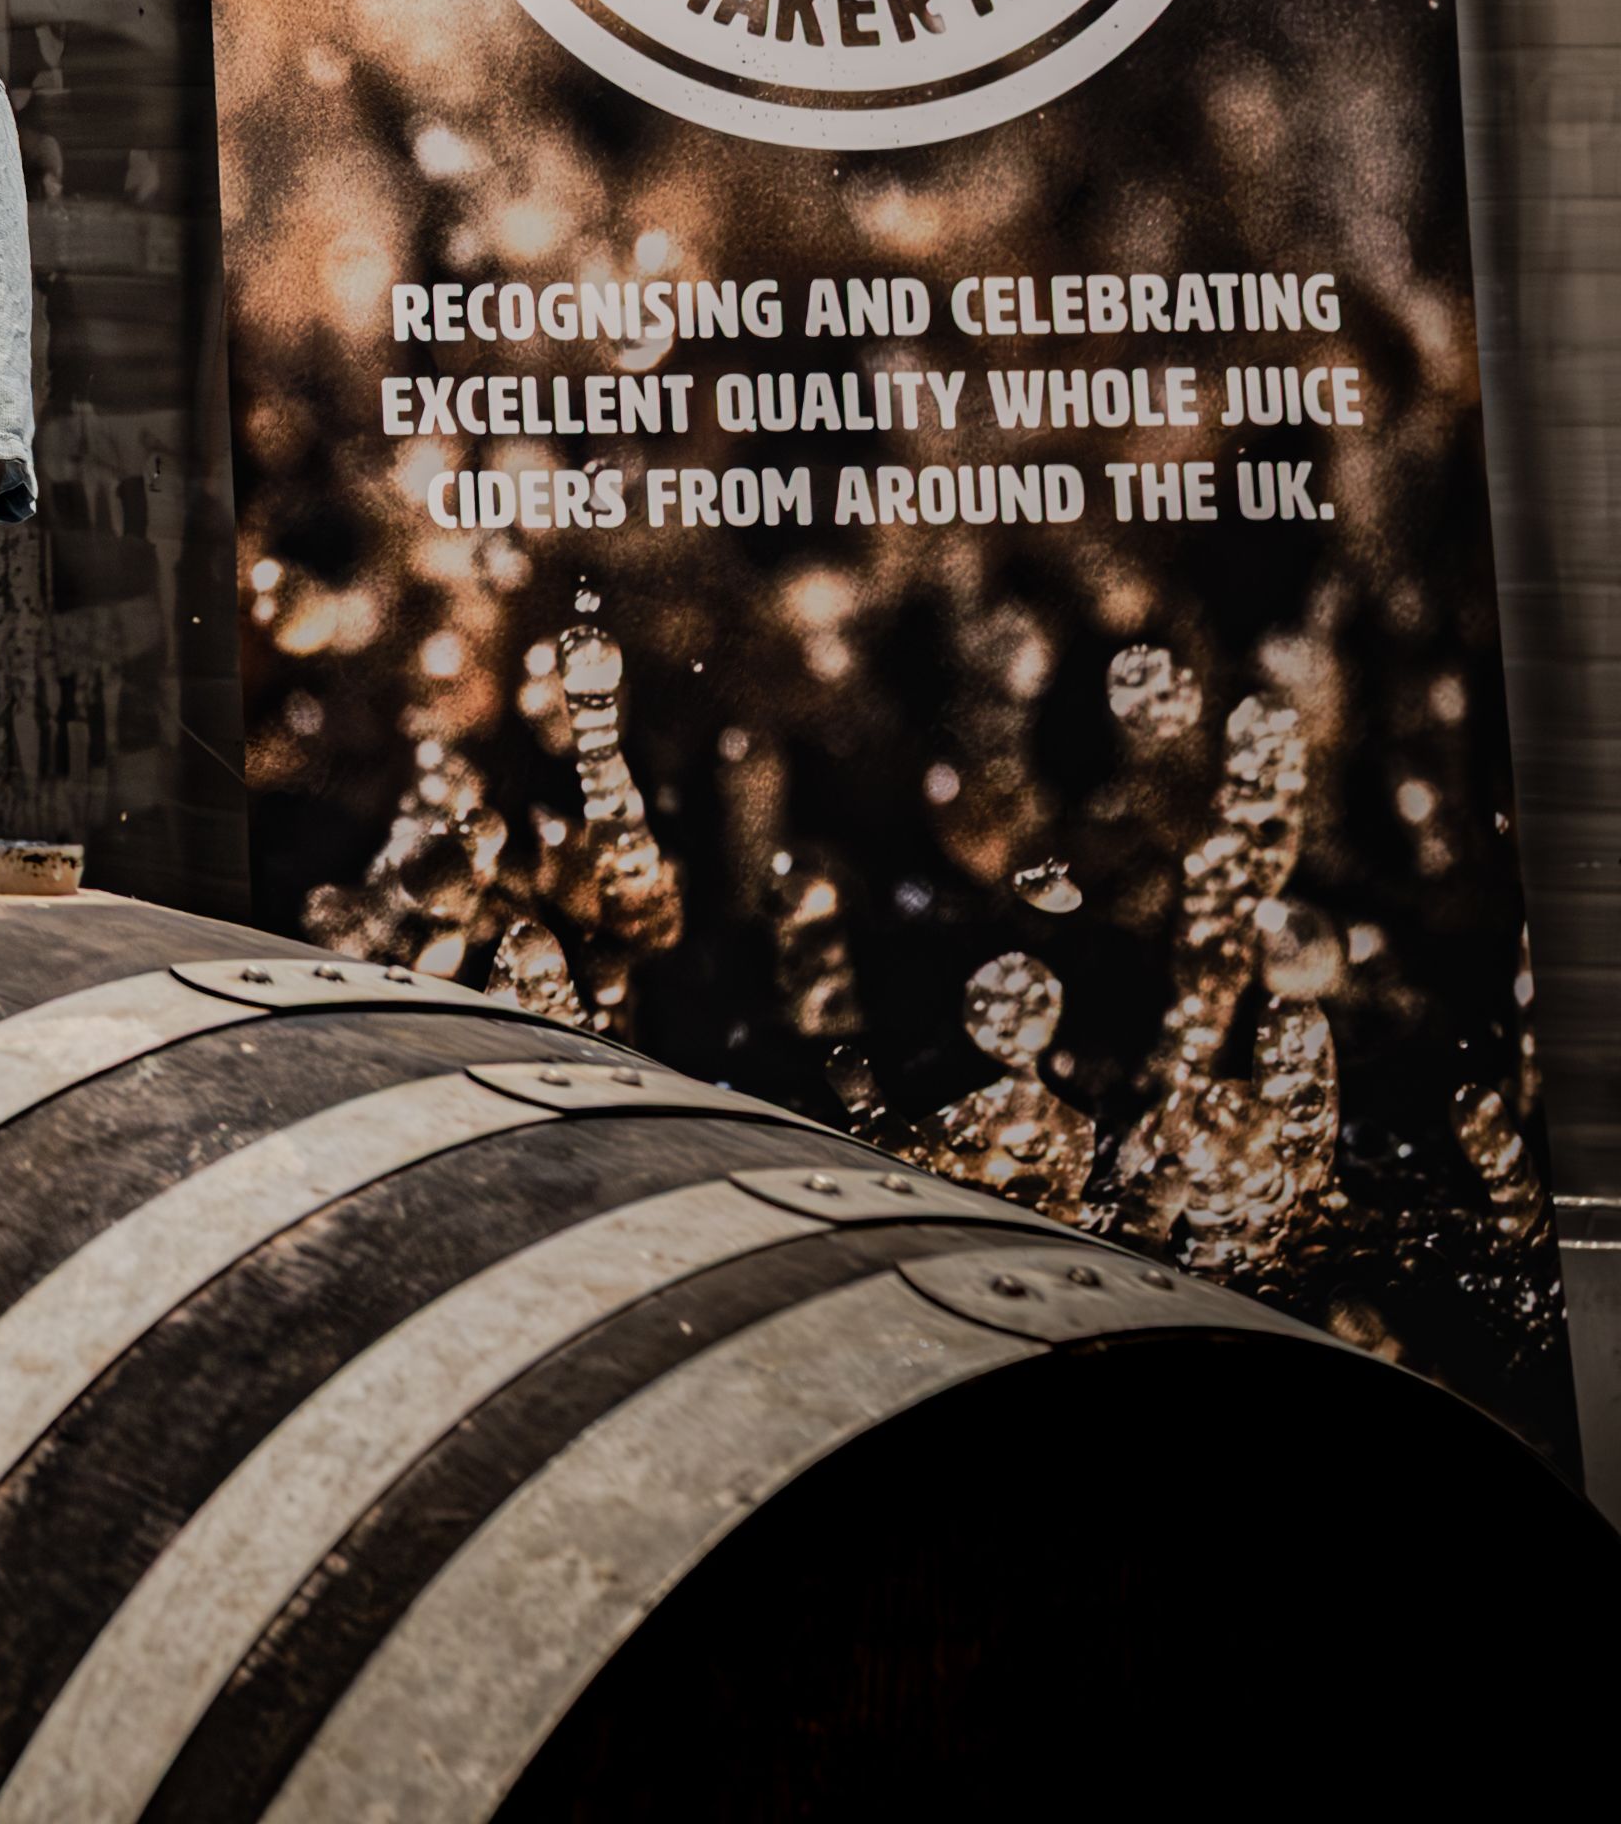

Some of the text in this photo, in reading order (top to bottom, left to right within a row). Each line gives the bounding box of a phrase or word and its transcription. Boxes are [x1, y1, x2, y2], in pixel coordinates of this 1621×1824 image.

[391, 273, 1342, 342] RECOGNISING AND CELEBRATING
[381, 366, 1364, 436] EXCELLENT QUALITY WHOLE JUICE
[426, 460, 1335, 530] CIDERS FROM AROUND THE UK.
